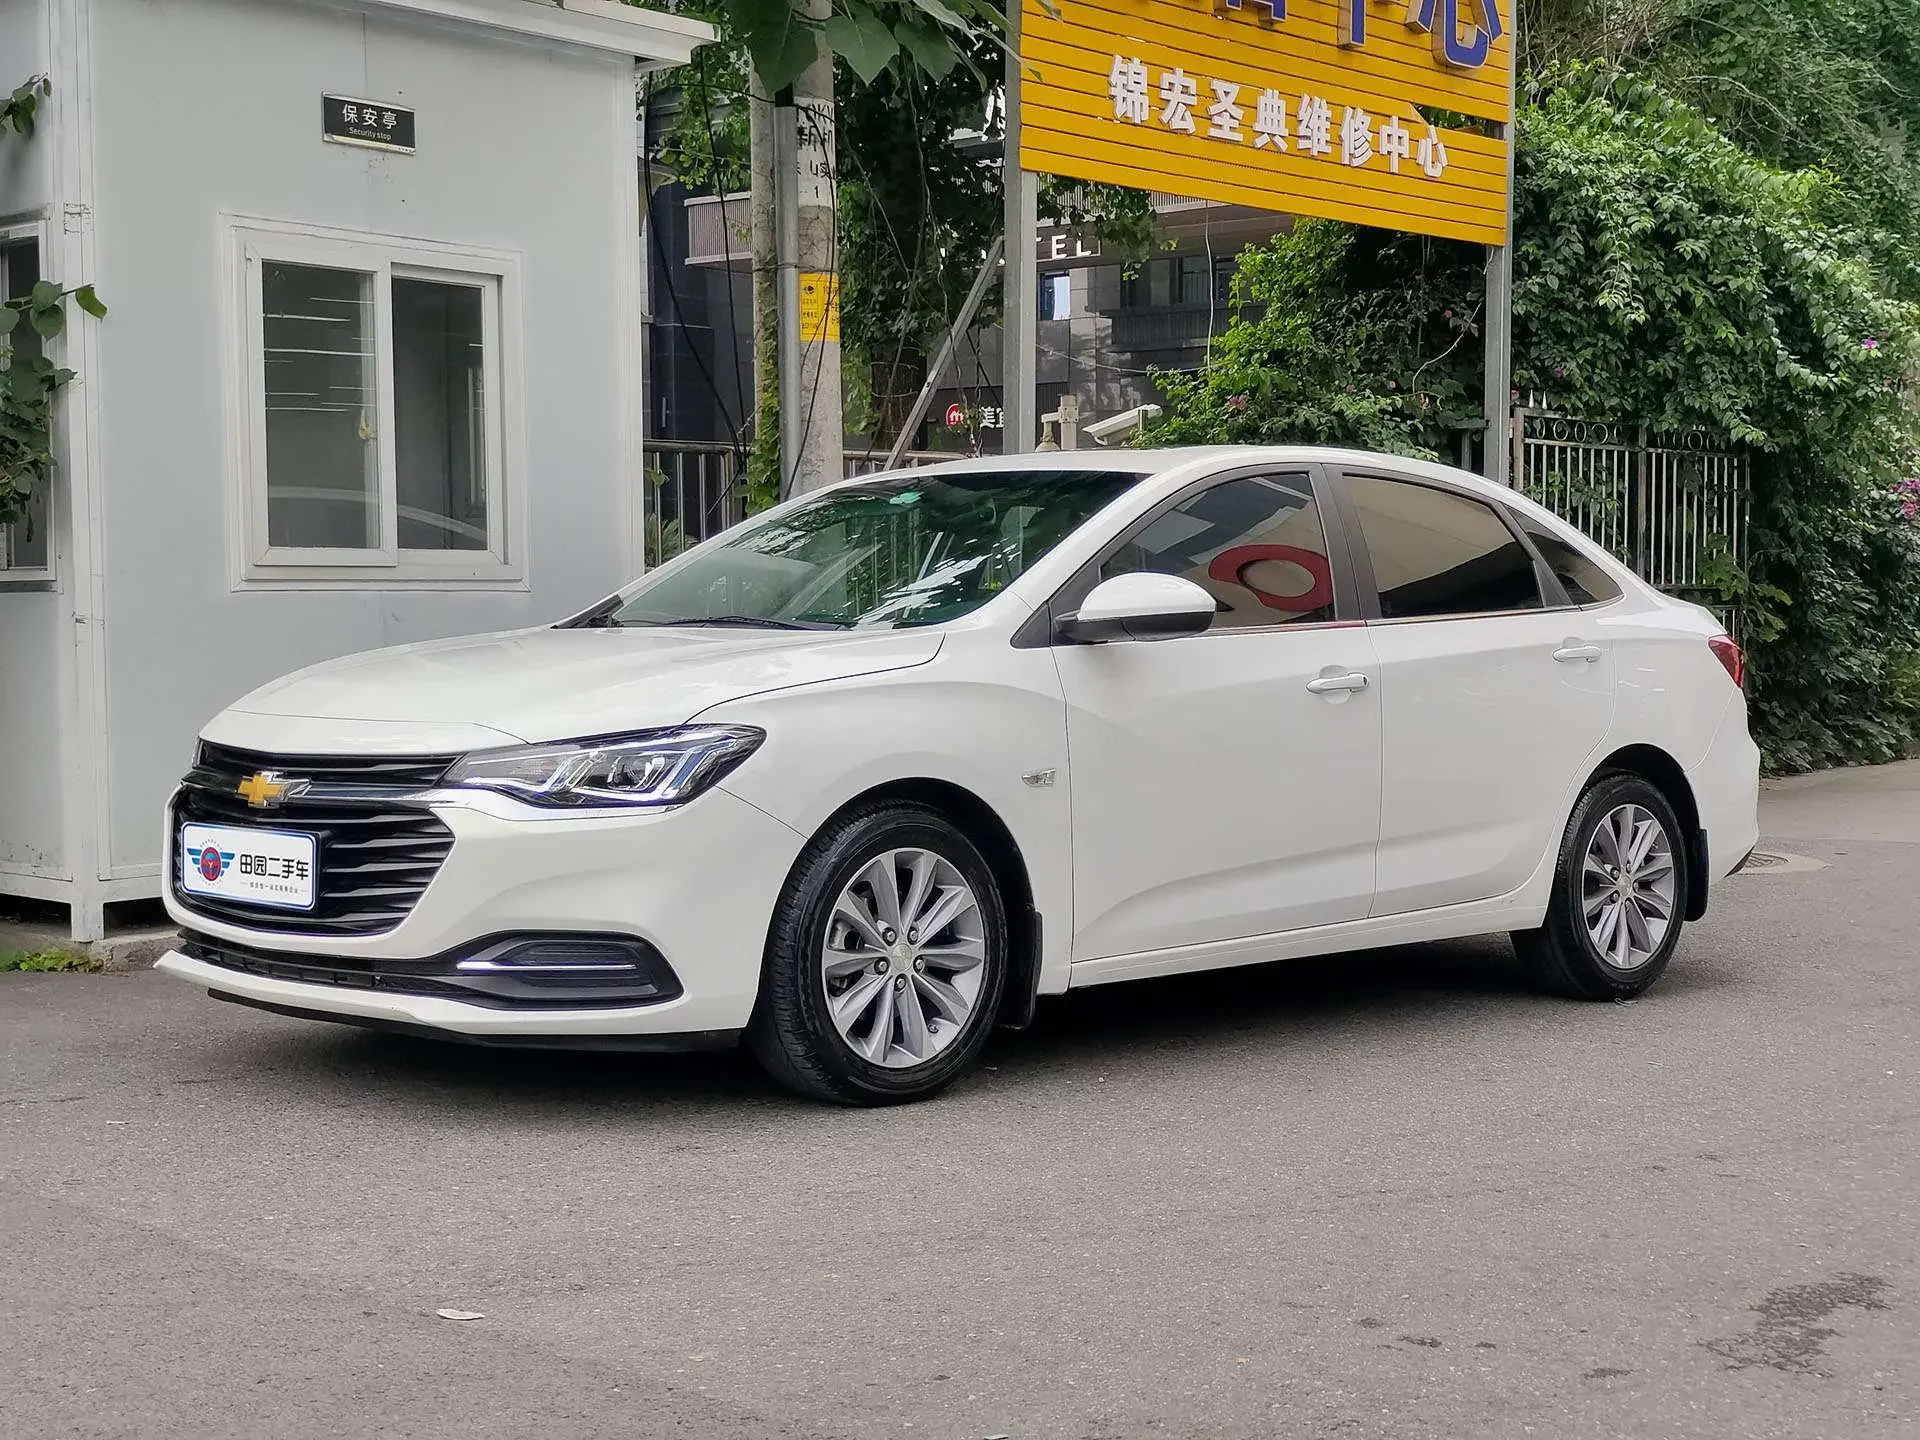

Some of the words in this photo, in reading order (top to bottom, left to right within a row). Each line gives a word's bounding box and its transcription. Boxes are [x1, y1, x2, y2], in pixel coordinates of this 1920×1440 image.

[342, 103, 397, 129] 保安亭
[1109, 54, 1449, 178] 锦宏圣典维修中心
[348, 126, 377, 139] Security
[377, 131, 392, 141] stop
[1036, 234, 1092, 259] EL
[240, 853, 309, 880] 田园二手车
